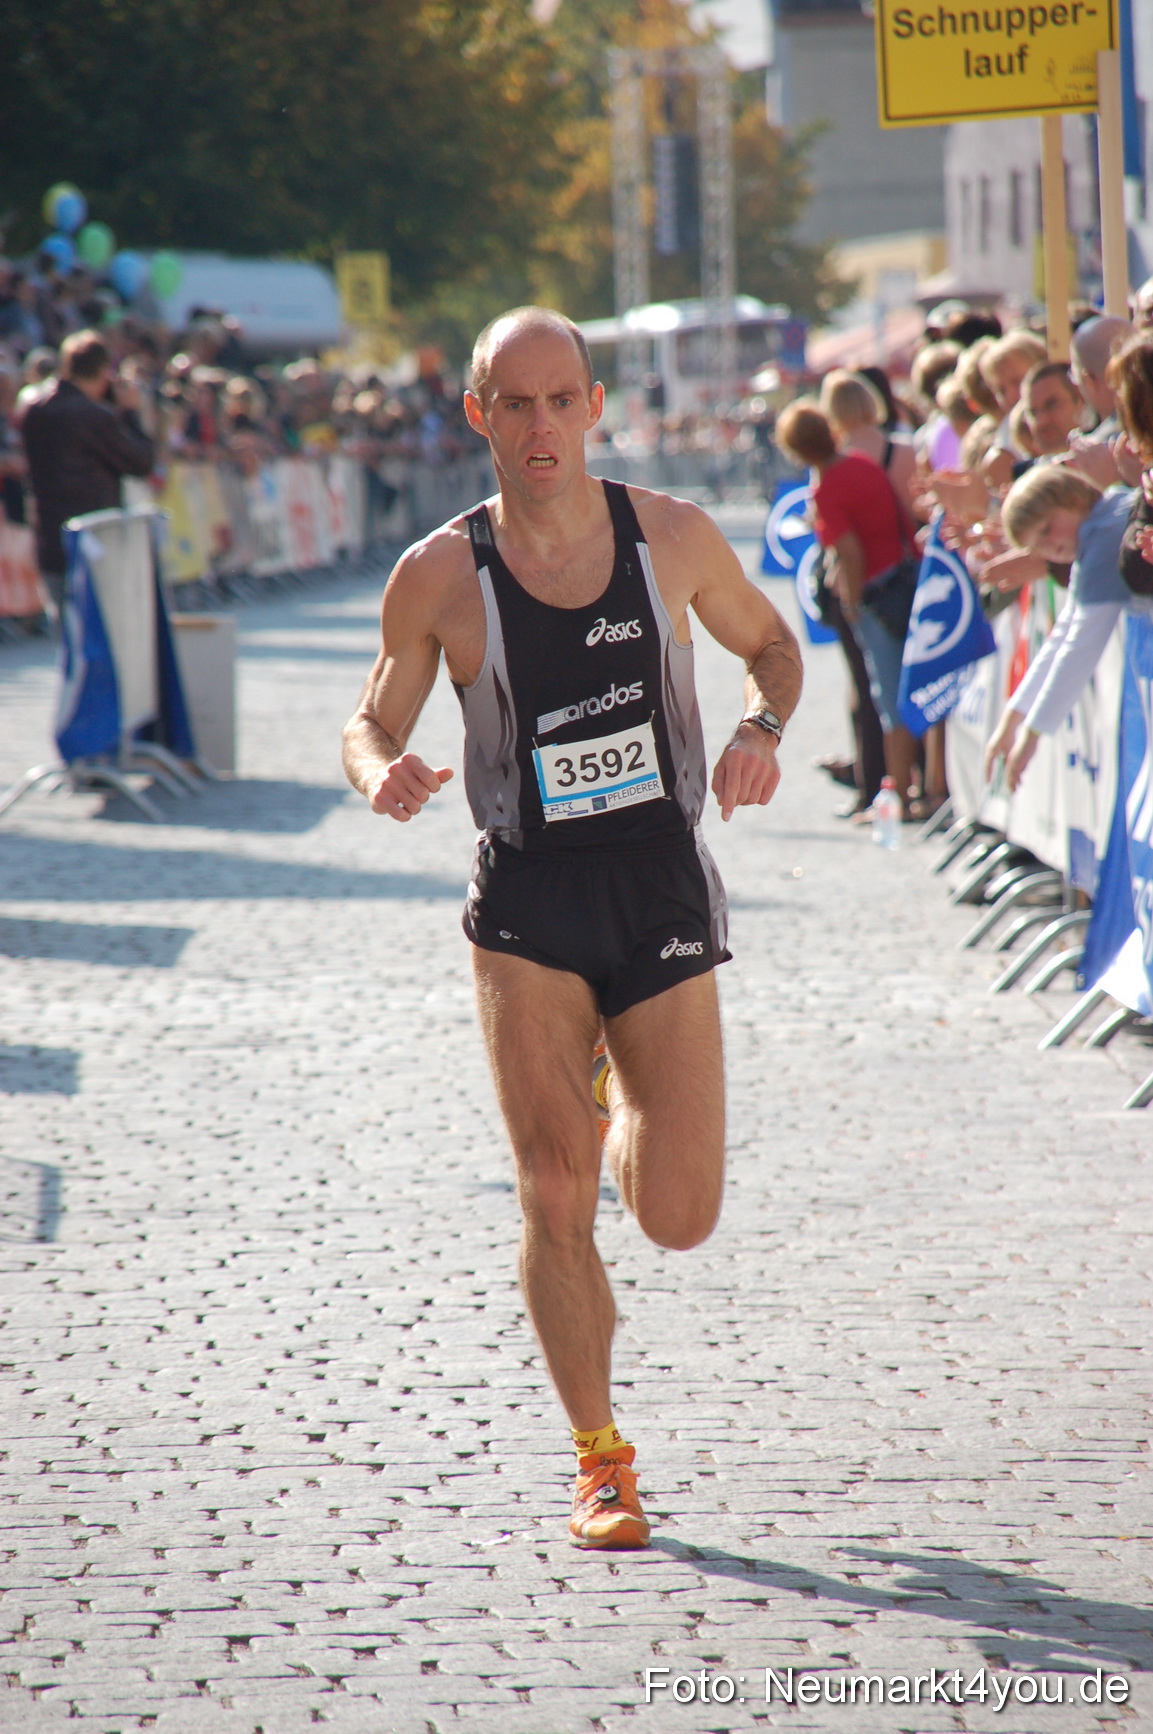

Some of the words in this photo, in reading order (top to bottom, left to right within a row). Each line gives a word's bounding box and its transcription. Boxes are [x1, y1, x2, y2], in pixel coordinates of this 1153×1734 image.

[893, 1, 1098, 39] Schnupper-
[964, 44, 1029, 78] lauf
[564, 681, 644, 722] arados
[554, 740, 646, 788] 3592
[607, 780, 660, 803] PFLEIDERER
